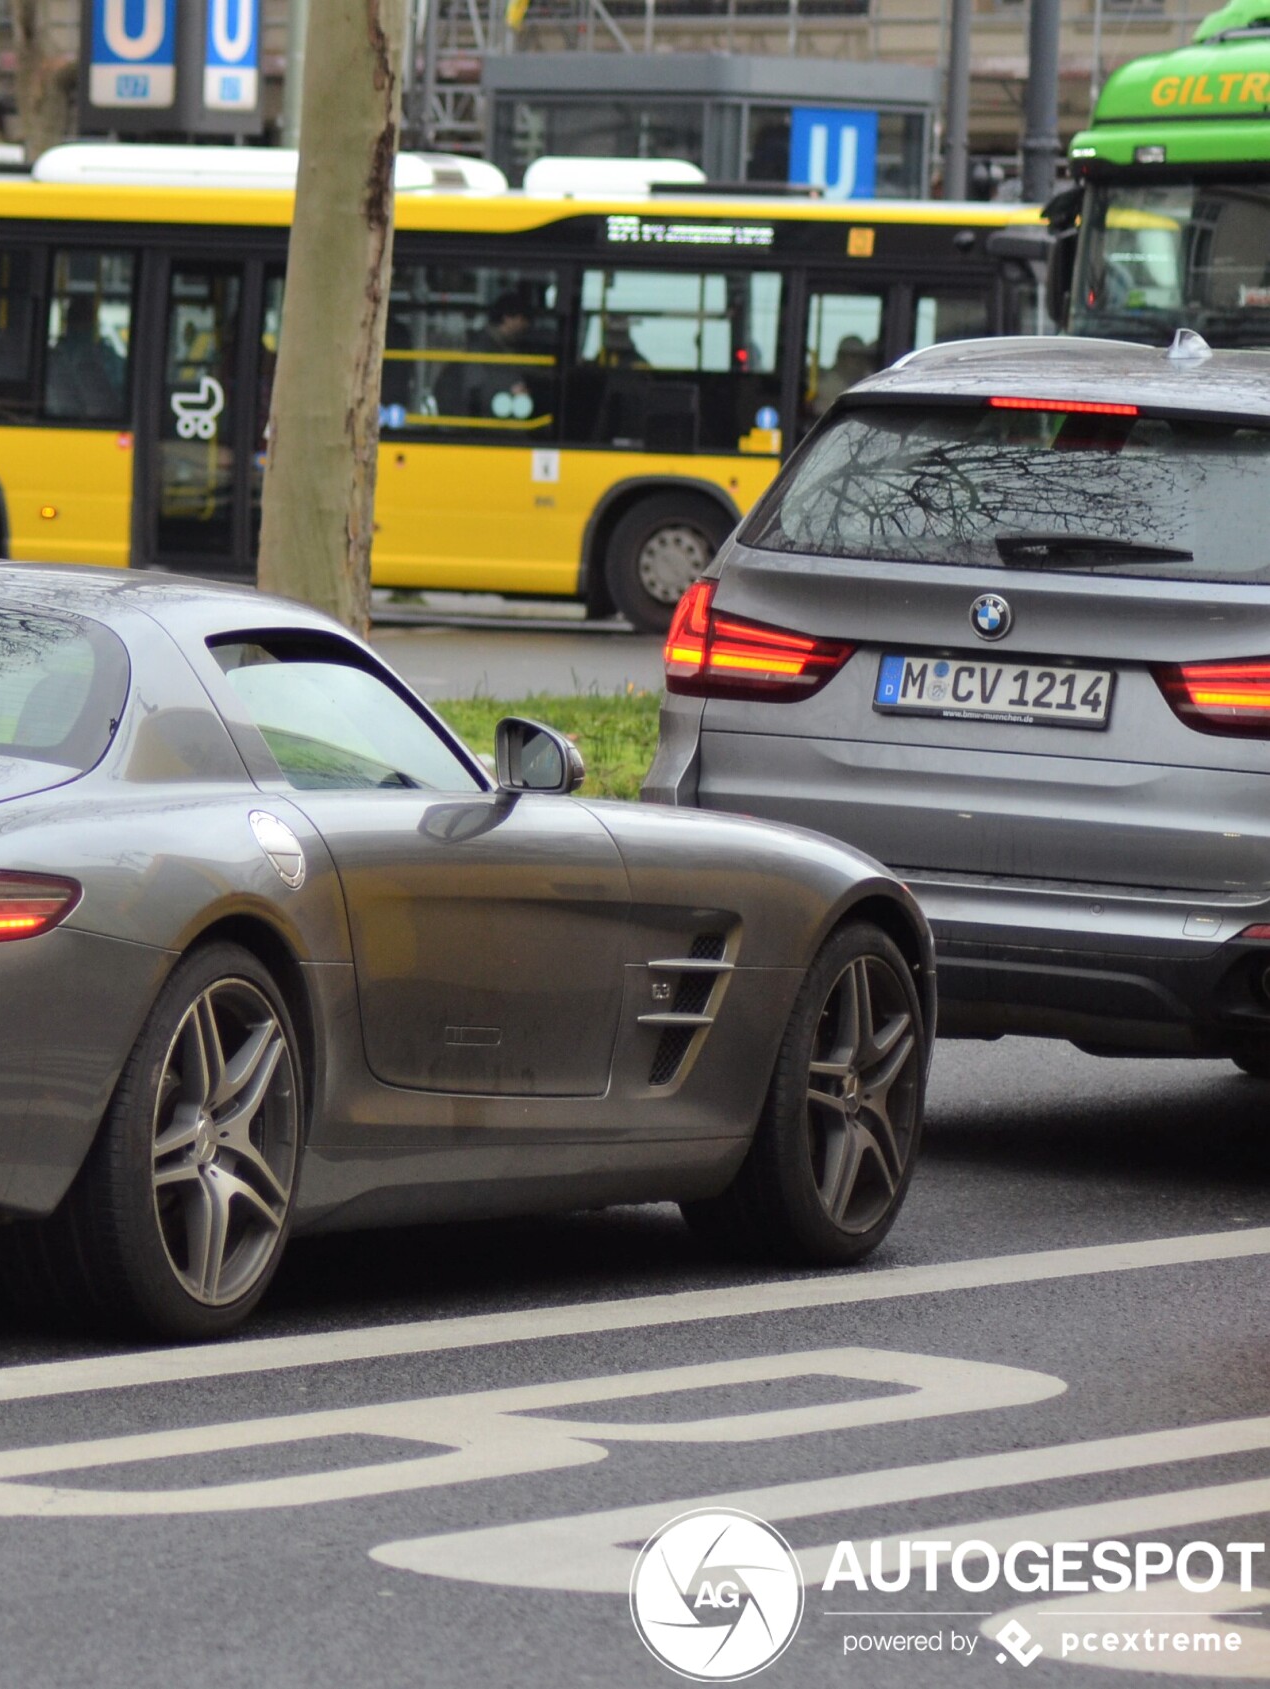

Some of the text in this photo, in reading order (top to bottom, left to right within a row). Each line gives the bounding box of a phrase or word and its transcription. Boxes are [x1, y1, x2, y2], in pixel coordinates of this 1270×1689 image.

[103, 0, 166, 61] U
[211, 0, 253, 63] U
[1150, 71, 1270, 107] GILTR
[808, 123, 858, 200] U
[901, 661, 1103, 713] M CV 1214
